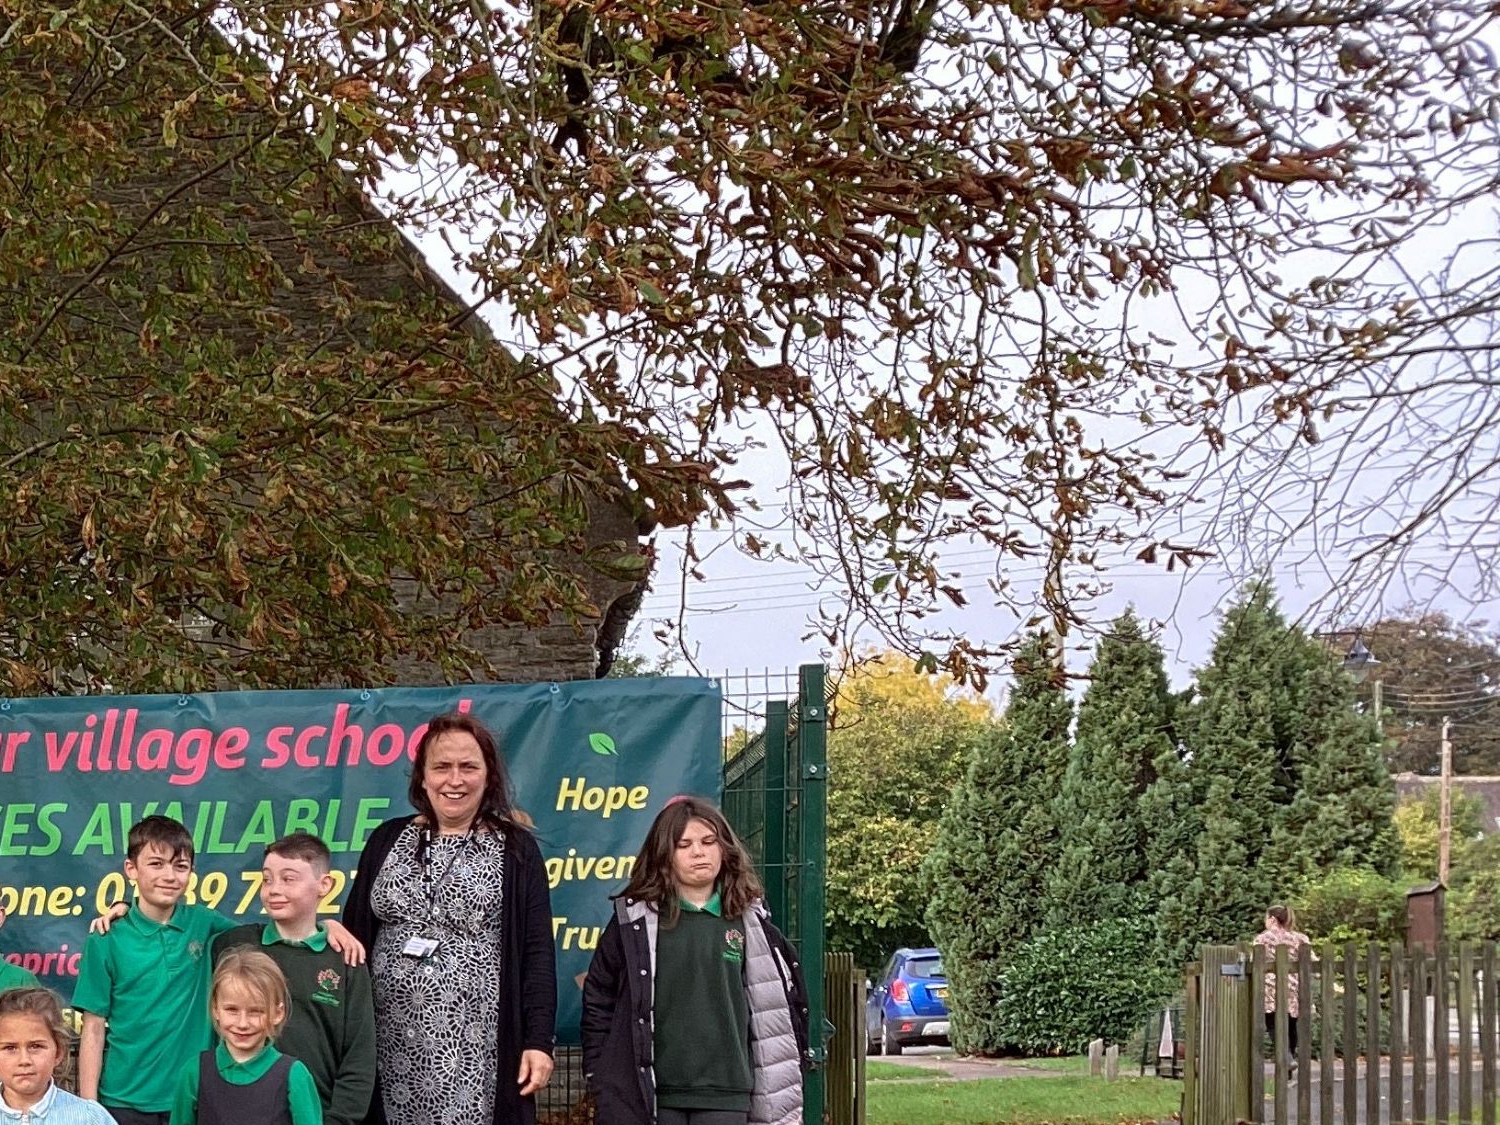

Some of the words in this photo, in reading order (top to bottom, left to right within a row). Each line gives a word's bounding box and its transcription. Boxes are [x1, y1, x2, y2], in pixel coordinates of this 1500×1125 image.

[44, 708, 250, 786] village
[260, 699, 473, 769] scho
[555, 777, 649, 818] Hope
[551, 917, 605, 950] Tru
